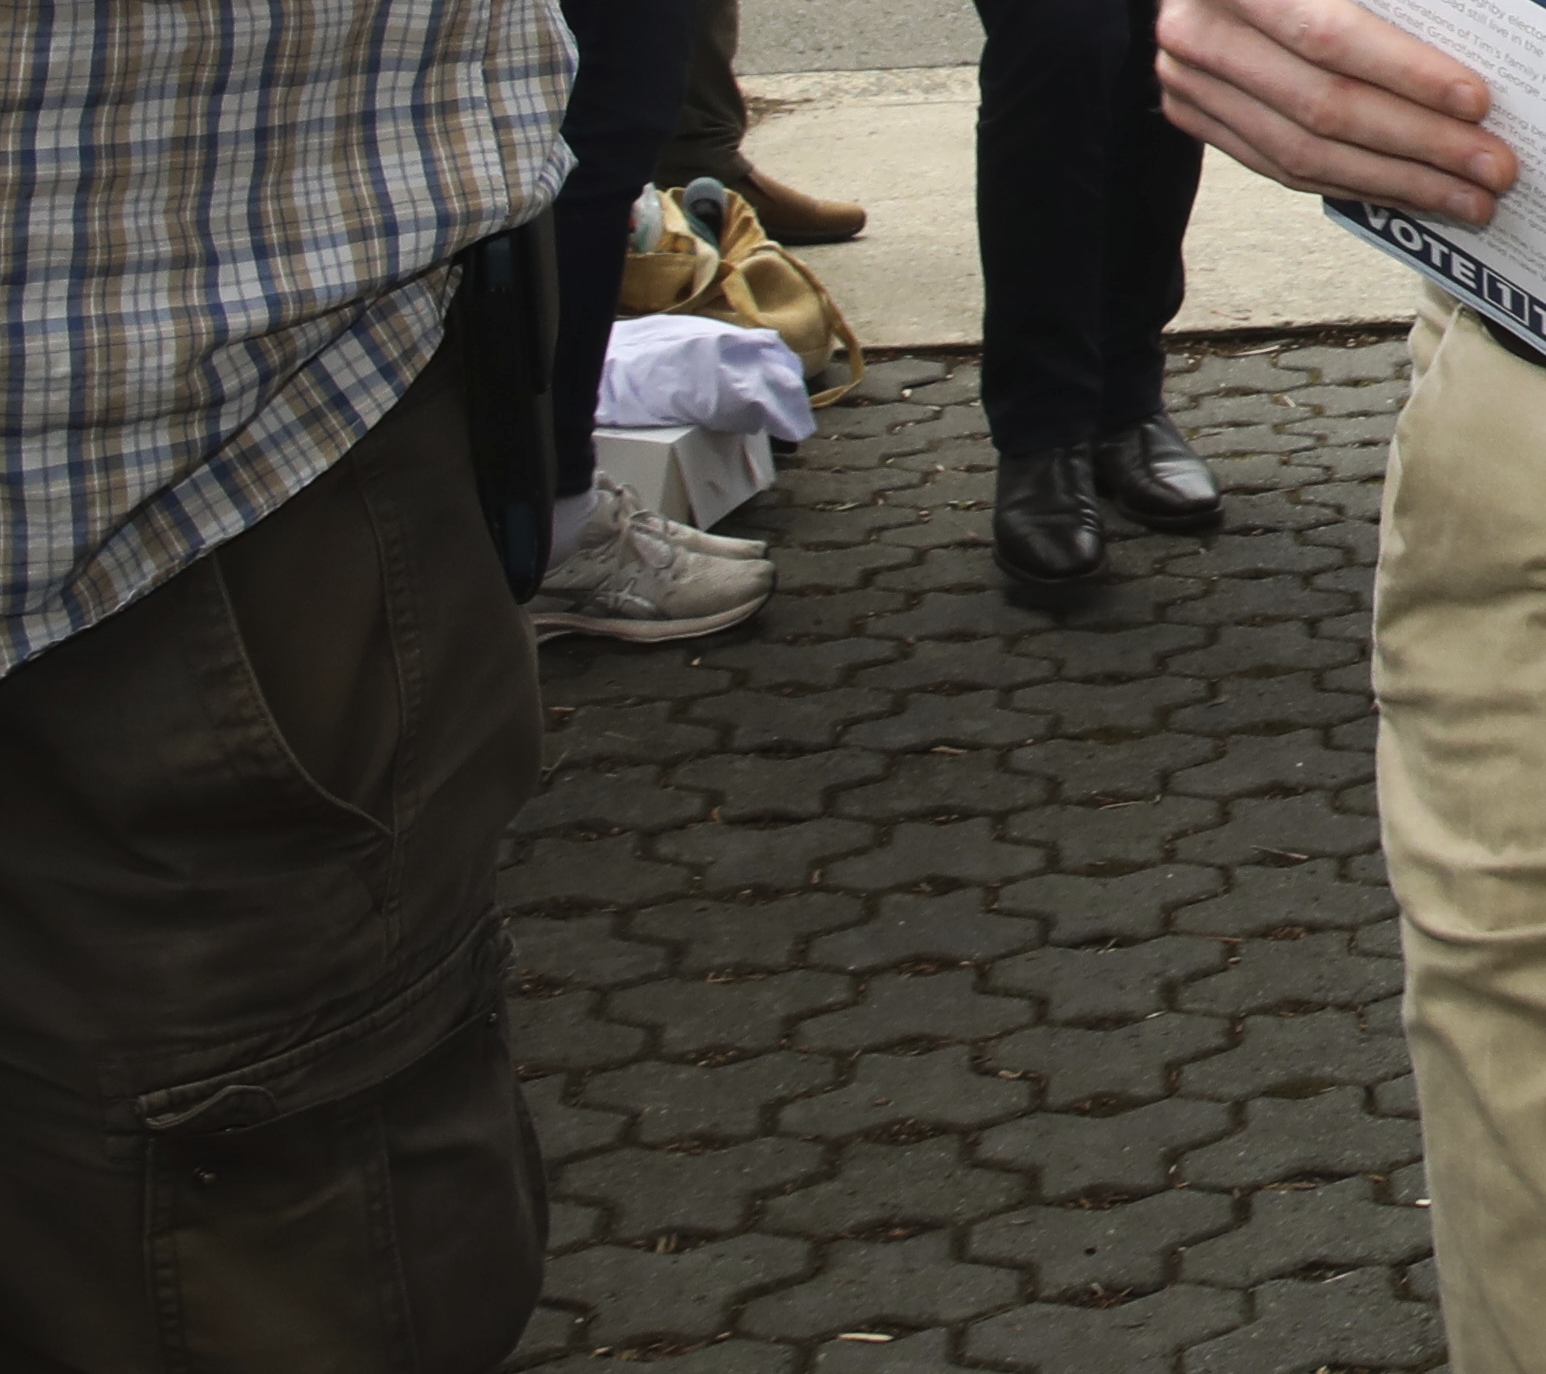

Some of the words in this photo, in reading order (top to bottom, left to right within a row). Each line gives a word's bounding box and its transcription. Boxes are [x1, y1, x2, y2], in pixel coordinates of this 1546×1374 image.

[1391, 5, 1426, 31] Great
[1425, 25, 1495, 71] Grandfather
[1494, 64, 1541, 98] George
[1455, 26, 1472, 41] of
[1501, 53, 1540, 81] family
[1464, 6, 1488, 25] still
[1486, 18, 1510, 38] live
[1509, 32, 1524, 46] in
[1521, 38, 1545, 58] the
[1362, 203, 1478, 290] VOTE
[1494, 282, 1516, 313] 1
